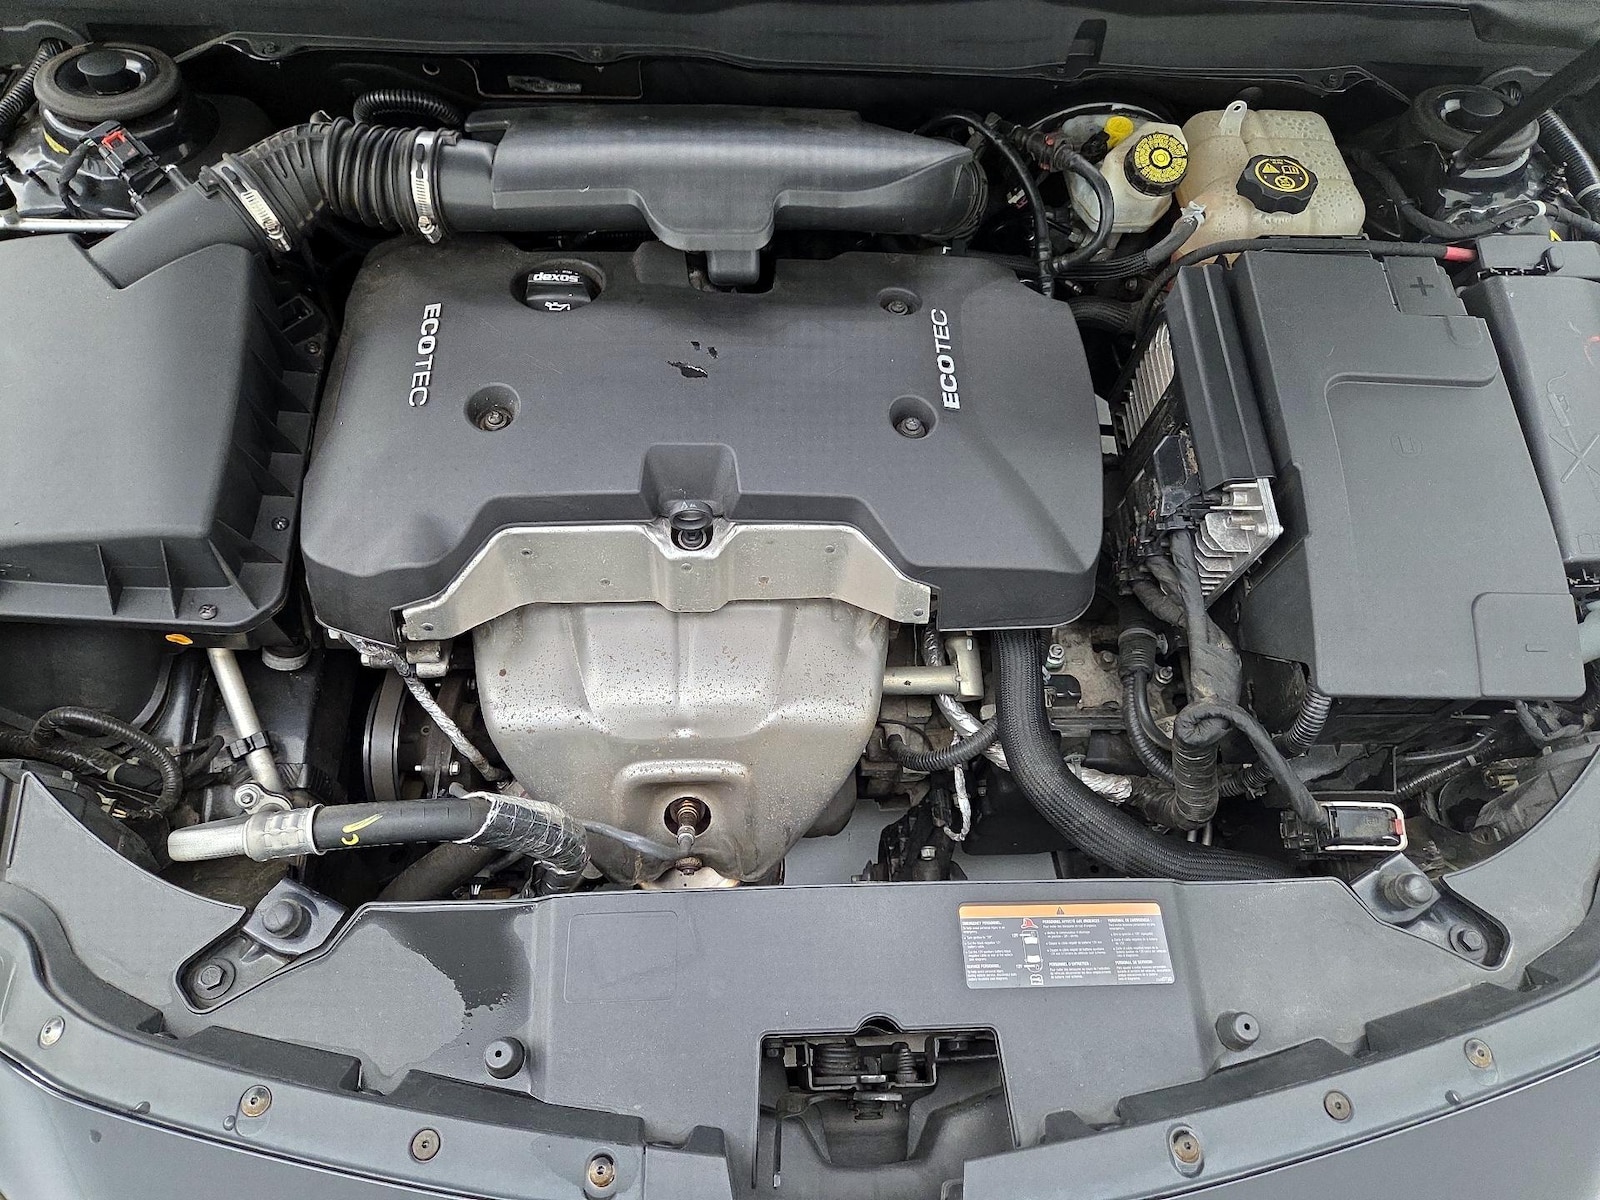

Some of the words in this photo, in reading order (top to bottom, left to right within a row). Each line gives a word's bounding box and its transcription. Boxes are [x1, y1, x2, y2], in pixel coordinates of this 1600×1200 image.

[533, 271, 580, 283] dexos
[408, 302, 442, 407] ECOTEC
[931, 308, 961, 410] ECOTEC
